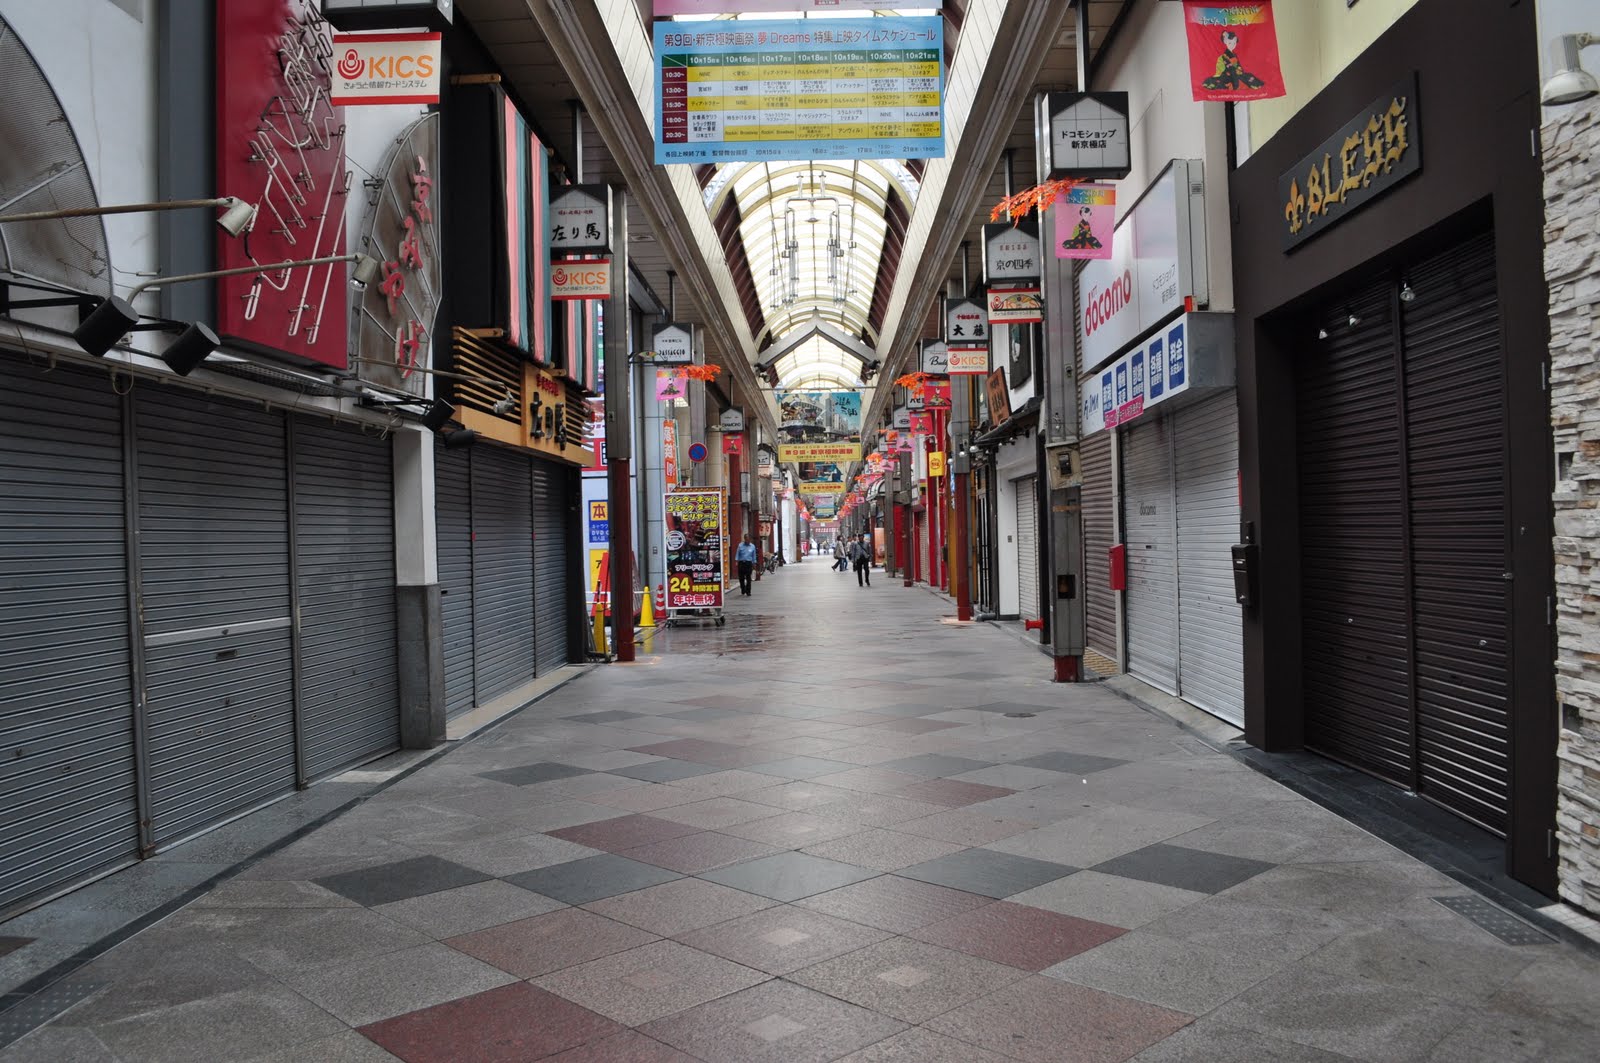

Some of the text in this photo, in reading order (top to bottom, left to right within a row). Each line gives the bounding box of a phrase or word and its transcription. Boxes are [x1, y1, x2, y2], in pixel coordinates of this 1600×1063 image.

[758, 34, 766, 43] 夢
[771, 32, 811, 44] Dreams
[814, 29, 937, 44] 特集上映タイムスケジュール
[369, 55, 433, 79] KICS
[343, 80, 427, 89] きょうと情報カードシステム
[1061, 129, 1116, 139] ドコモショップ
[1071, 140, 1107, 149] 新京極店
[1307, 97, 1408, 224] BLESS
[552, 222, 600, 241] 左り馬
[996, 258, 1033, 270] 京の四季
[569, 271, 606, 285] KICS
[1085, 269, 1131, 336] docomo
[961, 356, 986, 366] KICS
[667, 495, 718, 504] インターネット
[593, 504, 606, 518] 本
[697, 503, 718, 511] ダーツ
[1139, 503, 1157, 516] docomo
[682, 512, 718, 521] ビリヤード
[670, 577, 690, 592] 24
[673, 594, 715, 605] 年中無休
